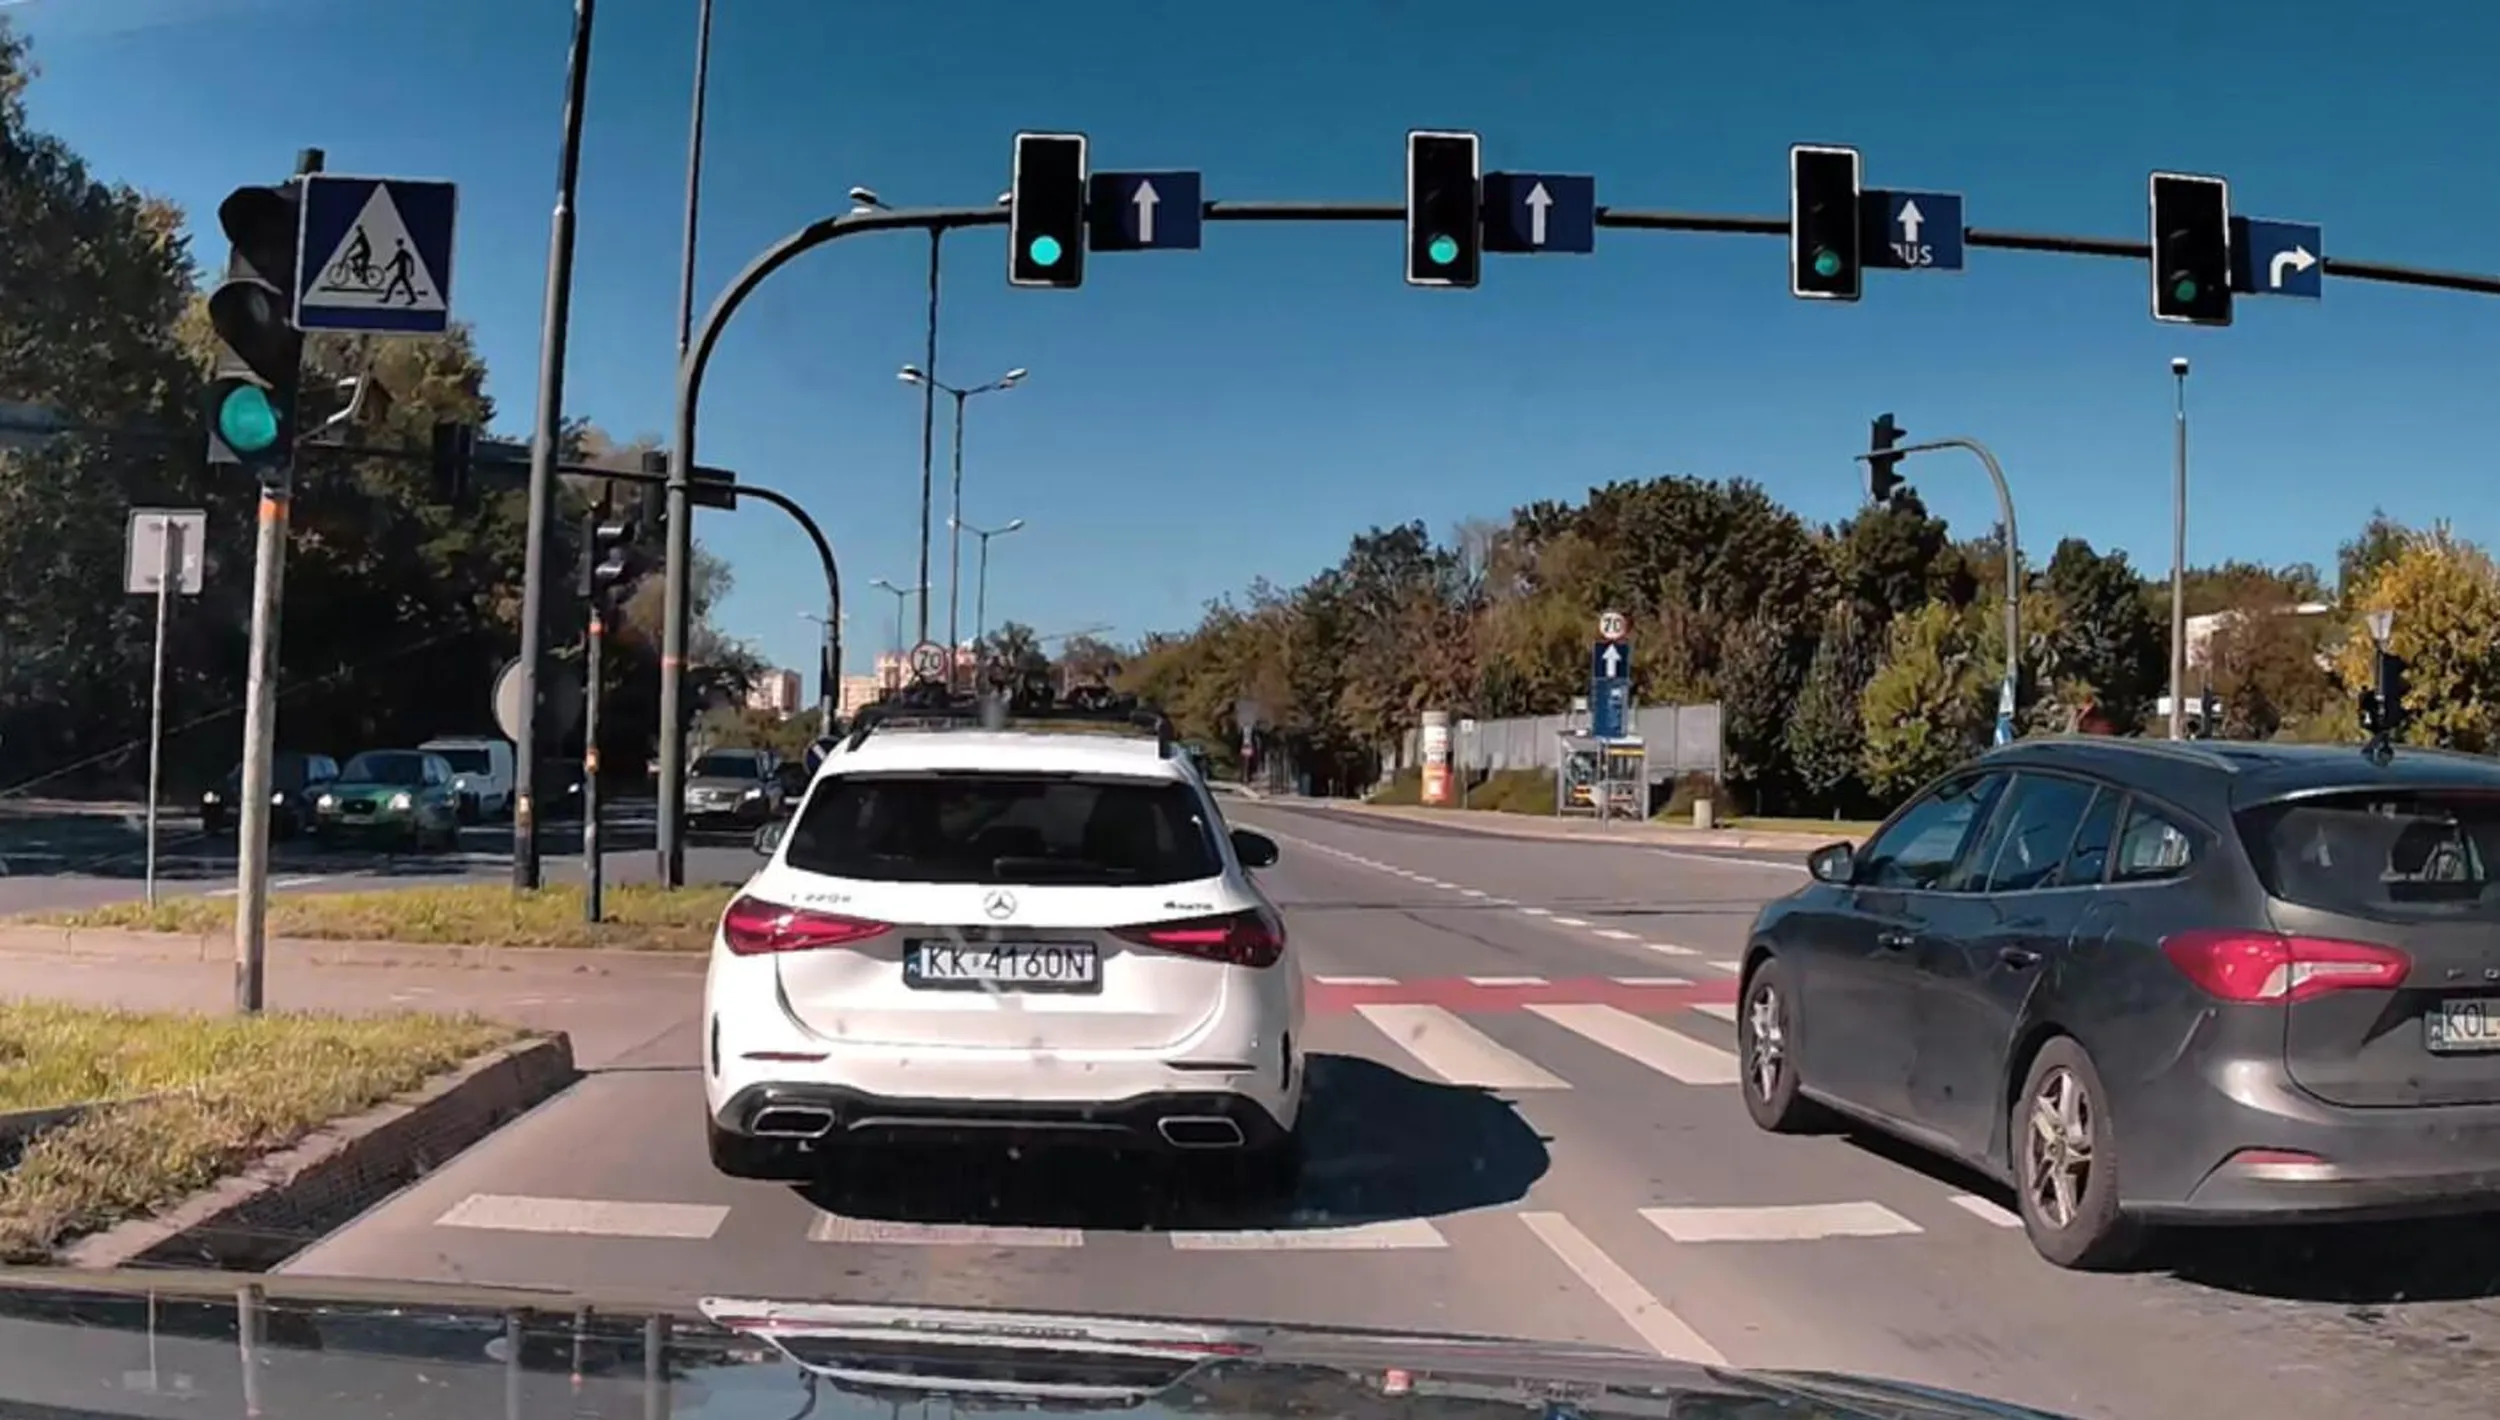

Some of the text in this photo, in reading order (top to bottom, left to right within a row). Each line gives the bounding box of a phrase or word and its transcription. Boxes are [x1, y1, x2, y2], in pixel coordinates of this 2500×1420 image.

[1603, 617, 1622, 633] 70
[919, 650, 942, 671] 70
[928, 946, 968, 977] KK
[984, 947, 1087, 979] 4160N
[2445, 1003, 2498, 1038] KOL
